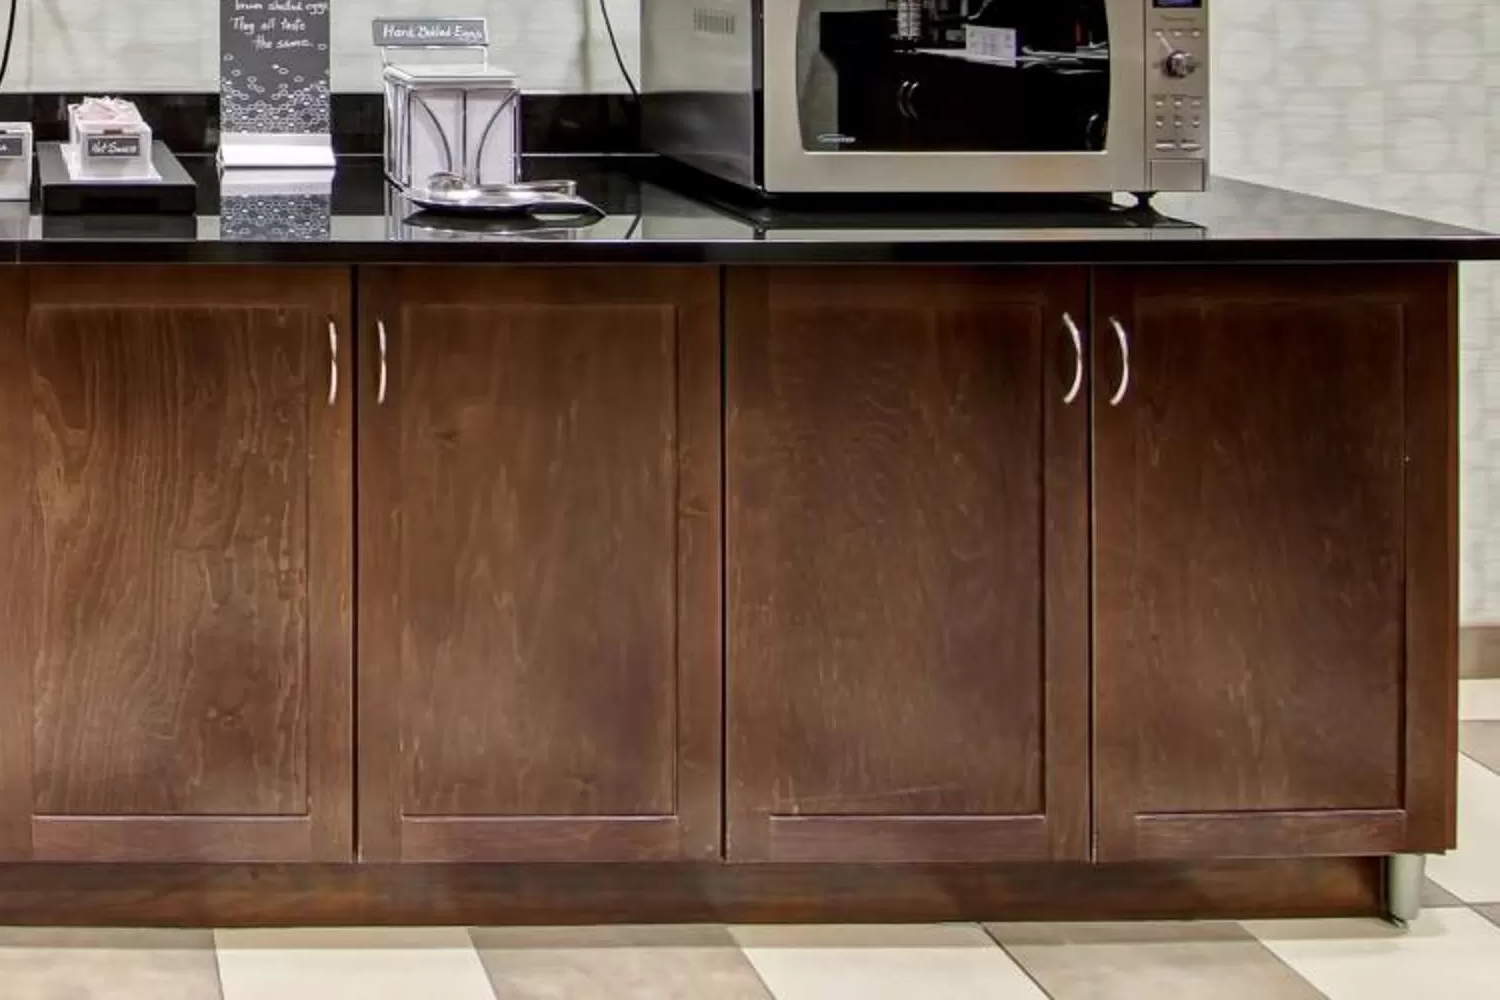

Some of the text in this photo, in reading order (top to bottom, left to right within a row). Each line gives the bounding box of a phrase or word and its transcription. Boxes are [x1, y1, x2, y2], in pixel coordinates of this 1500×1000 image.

[229, 15, 255, 35] They
[259, 16, 276, 32] all
[251, 34, 273, 50] the
